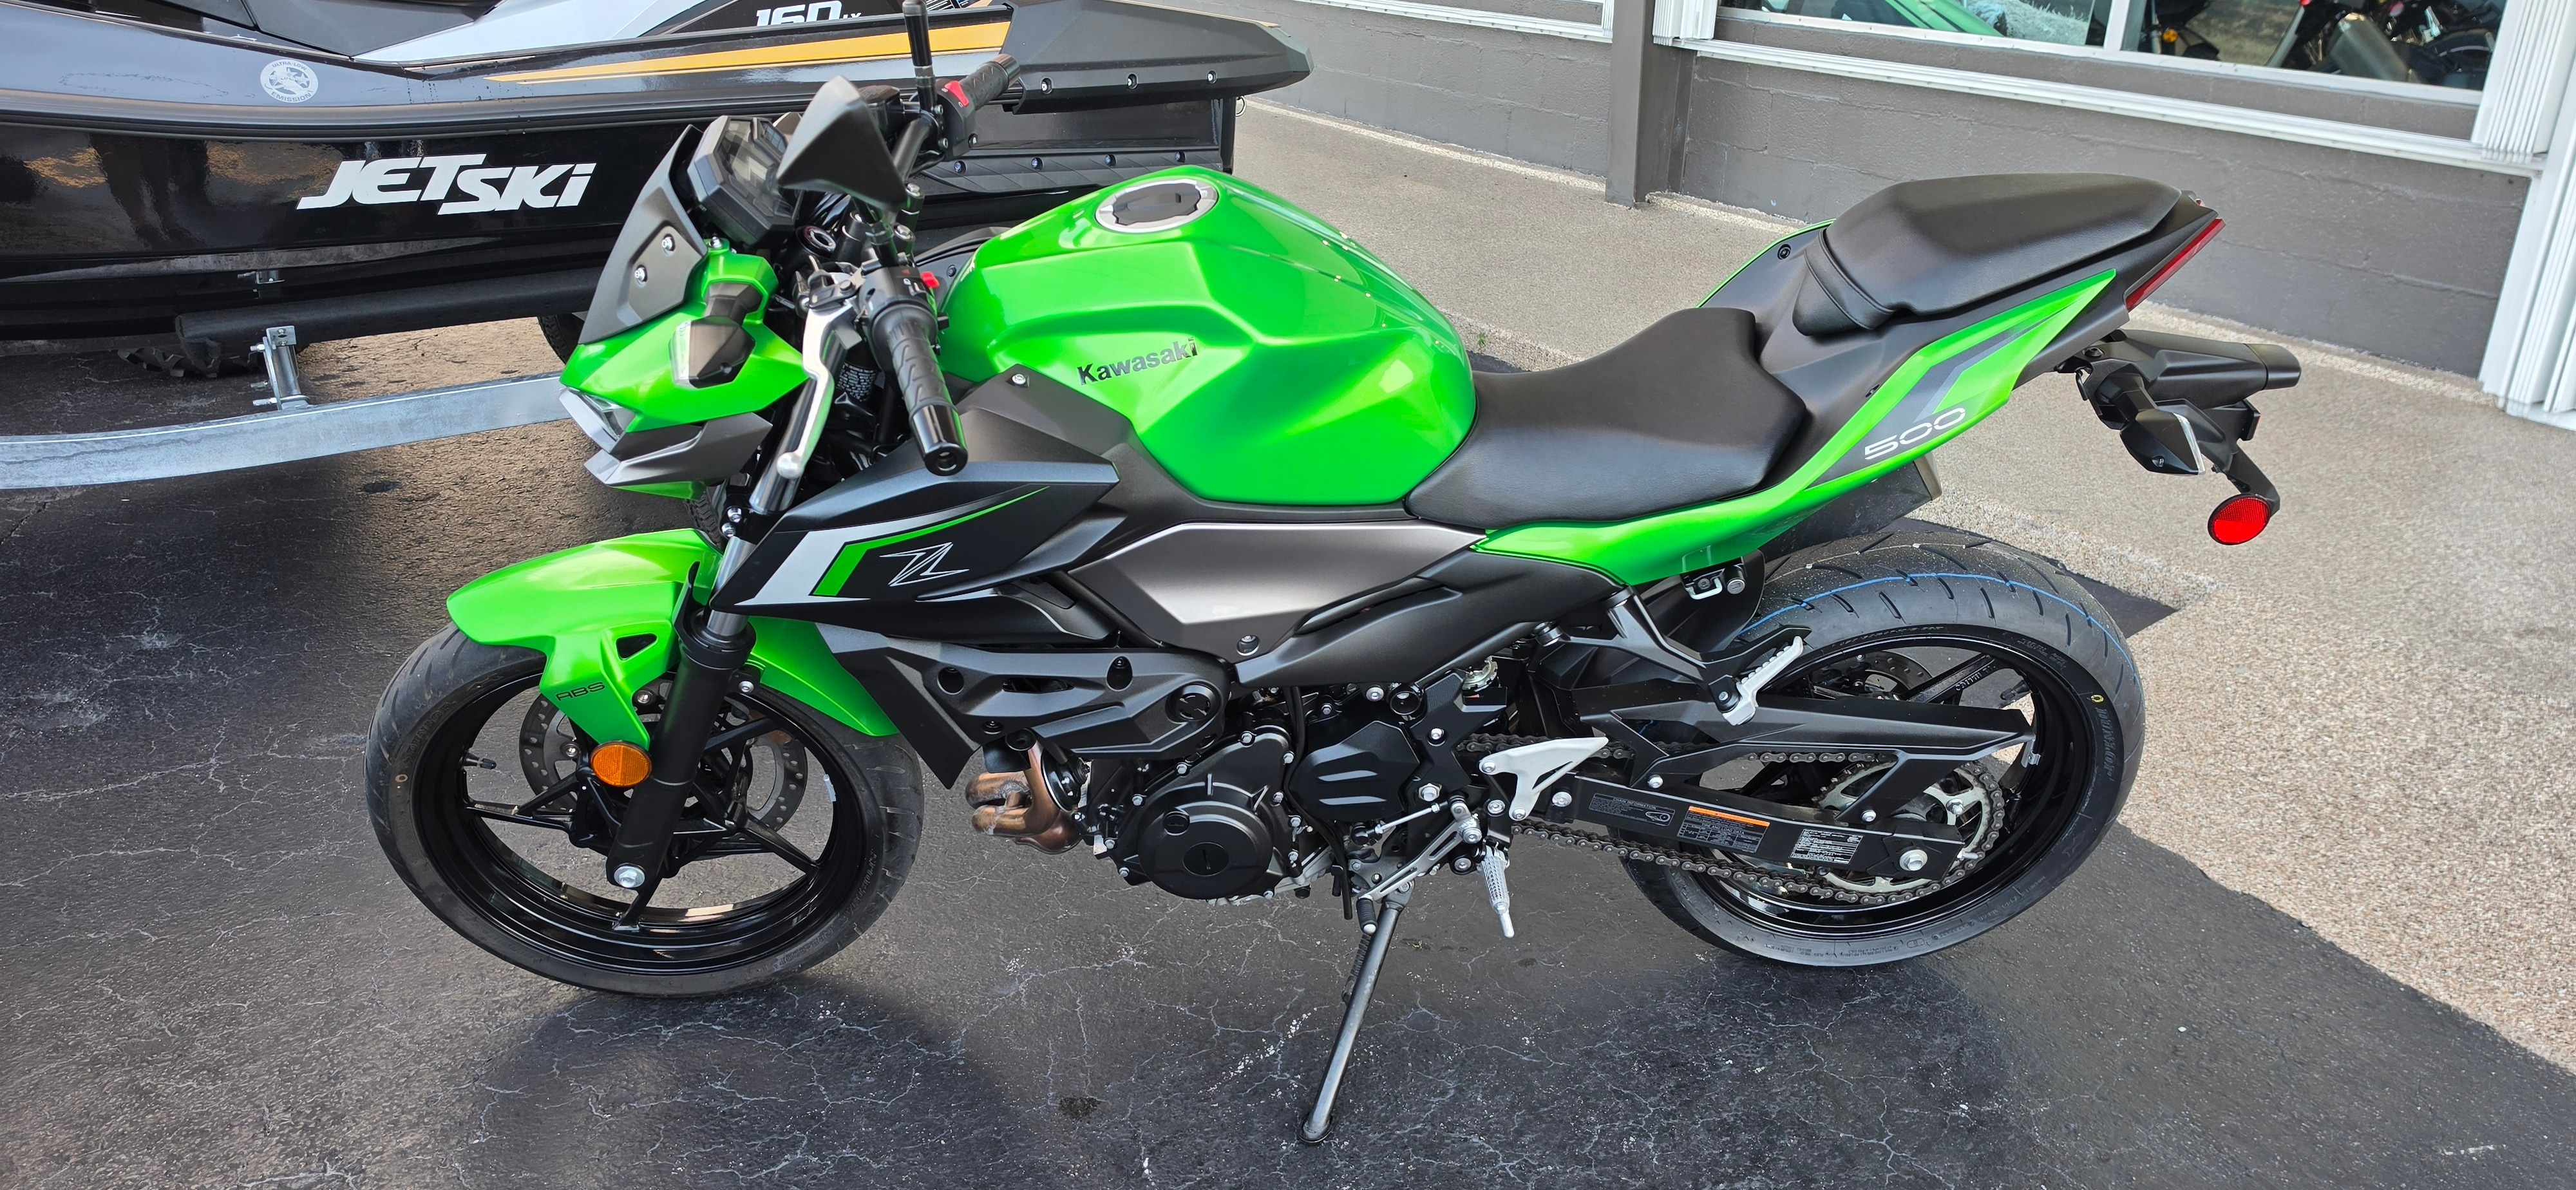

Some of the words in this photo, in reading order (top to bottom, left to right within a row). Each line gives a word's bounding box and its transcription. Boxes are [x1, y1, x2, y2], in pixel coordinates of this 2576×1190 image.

[272, 61, 307, 71] ULTRA-LOW
[270, 91, 312, 102] EMISSION
[1077, 336, 1198, 386] Kawasaki
[1864, 408, 1966, 460] 500
[555, 681, 605, 701] ABS
